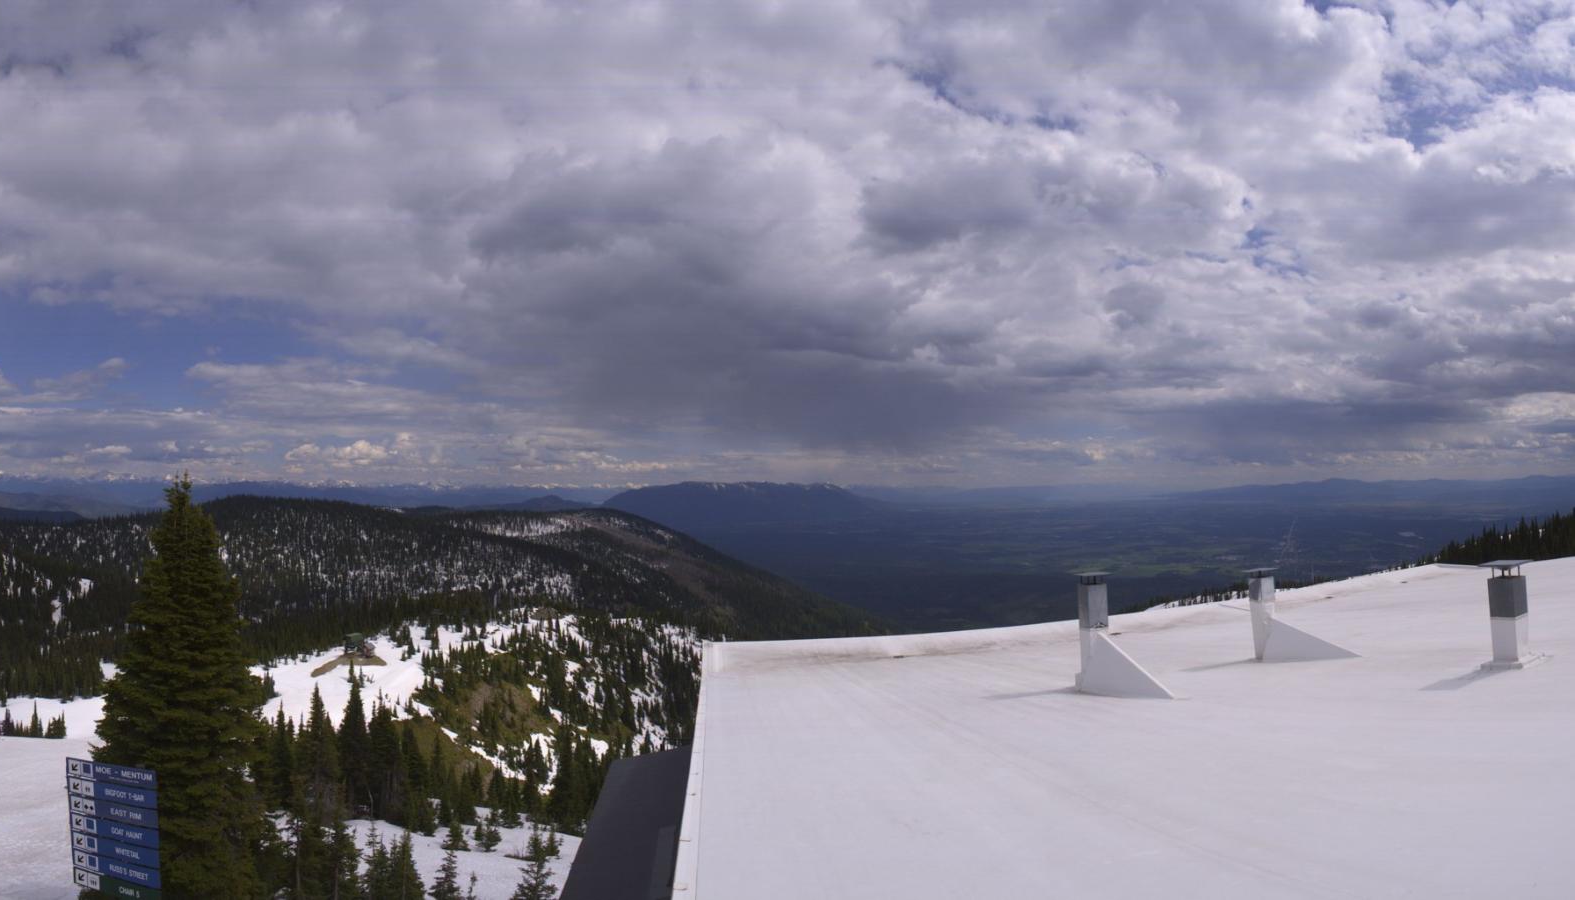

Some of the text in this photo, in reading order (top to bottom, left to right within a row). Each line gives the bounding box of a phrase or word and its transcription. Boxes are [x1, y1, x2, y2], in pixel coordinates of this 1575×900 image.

[95, 766, 111, 775] MOE
[121, 770, 153, 781] MENTUM
[105, 788, 127, 799] BIGFOOT
[110, 808, 142, 820] EAST RIM
[111, 826, 143, 840] GOAT HAUNT
[115, 847, 140, 860] WHITETAIL
[129, 869, 148, 881] STREET
[119, 886, 135, 897] CHAIR
